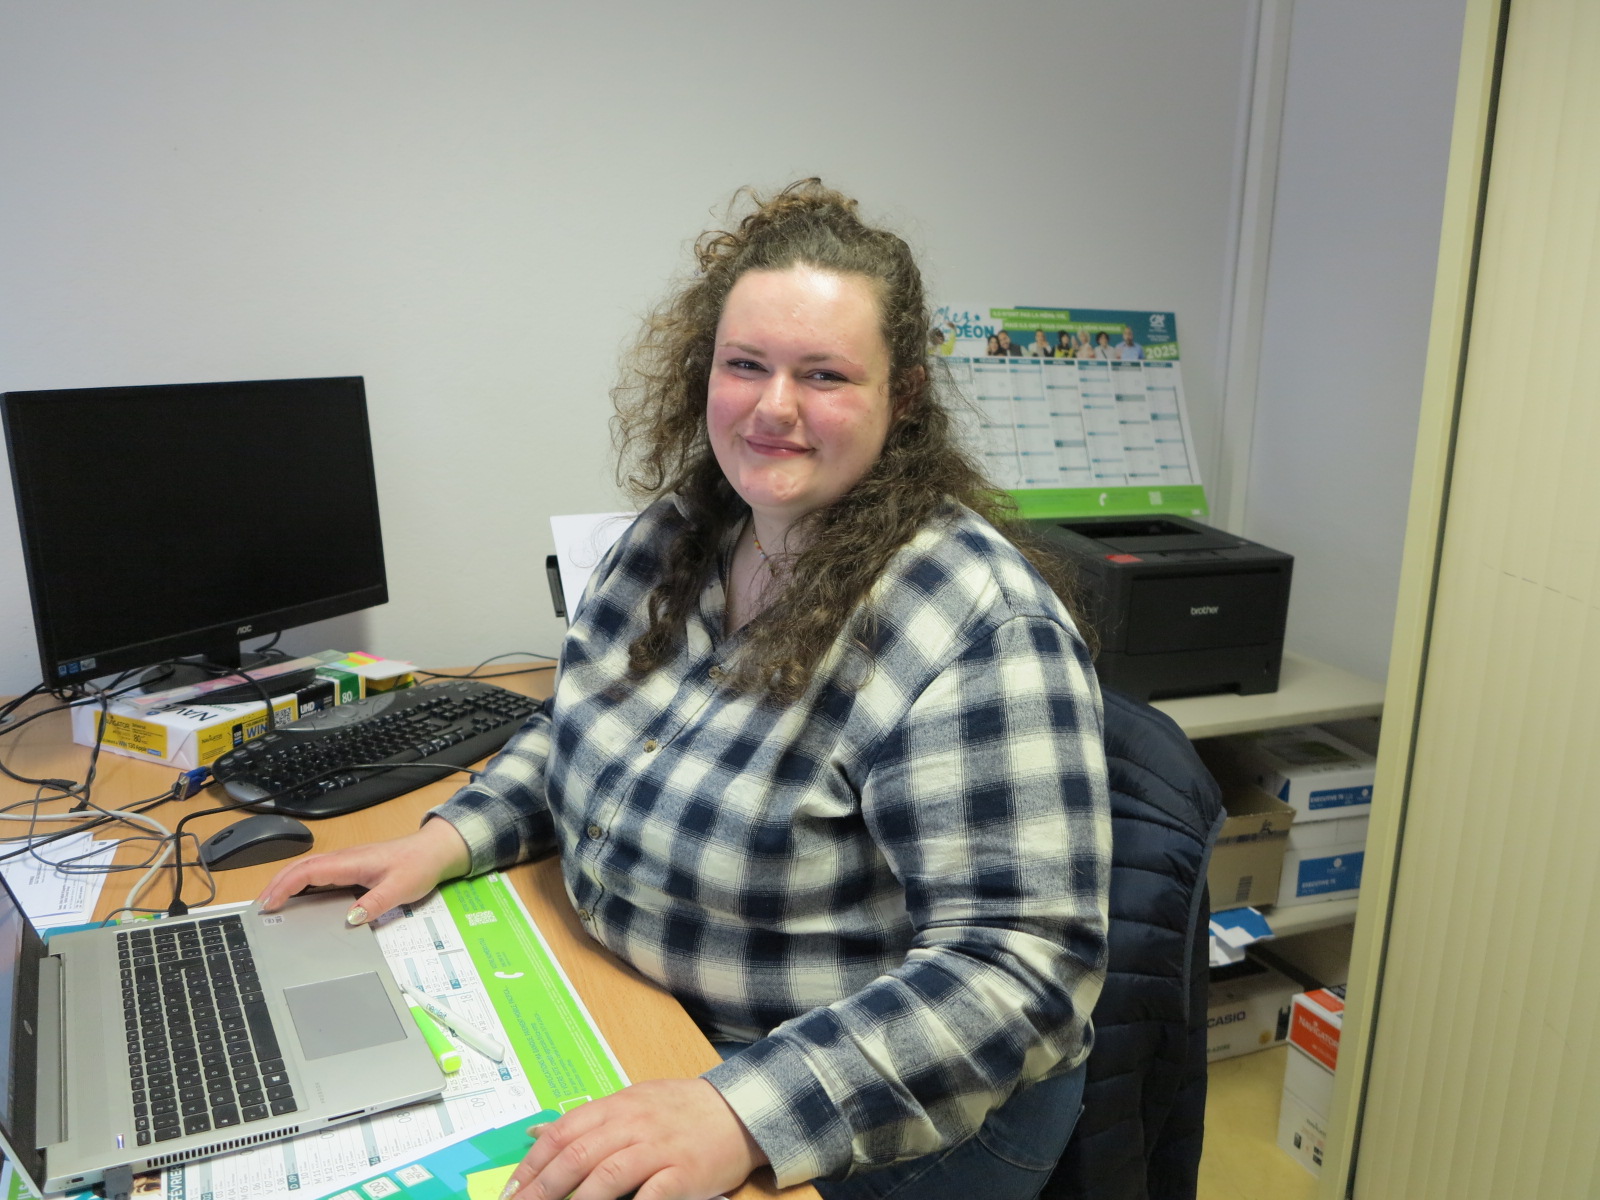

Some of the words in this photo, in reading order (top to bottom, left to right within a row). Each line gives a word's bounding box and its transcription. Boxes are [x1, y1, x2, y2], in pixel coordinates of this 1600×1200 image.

[1146, 344, 1178, 360] 2025
[1190, 606, 1219, 616] brother
[236, 625, 252, 634] AOC
[342, 691, 353, 703] 80
[300, 702, 315, 713] UHD
[247, 725, 268, 737] WIN
[462, 994, 473, 1003] 18
[1207, 1010, 1246, 1028] CASIO
[471, 1097, 486, 1108] 09
[396, 1111, 412, 1123] 08
[170, 1165, 182, 1200] FÉVRIER
